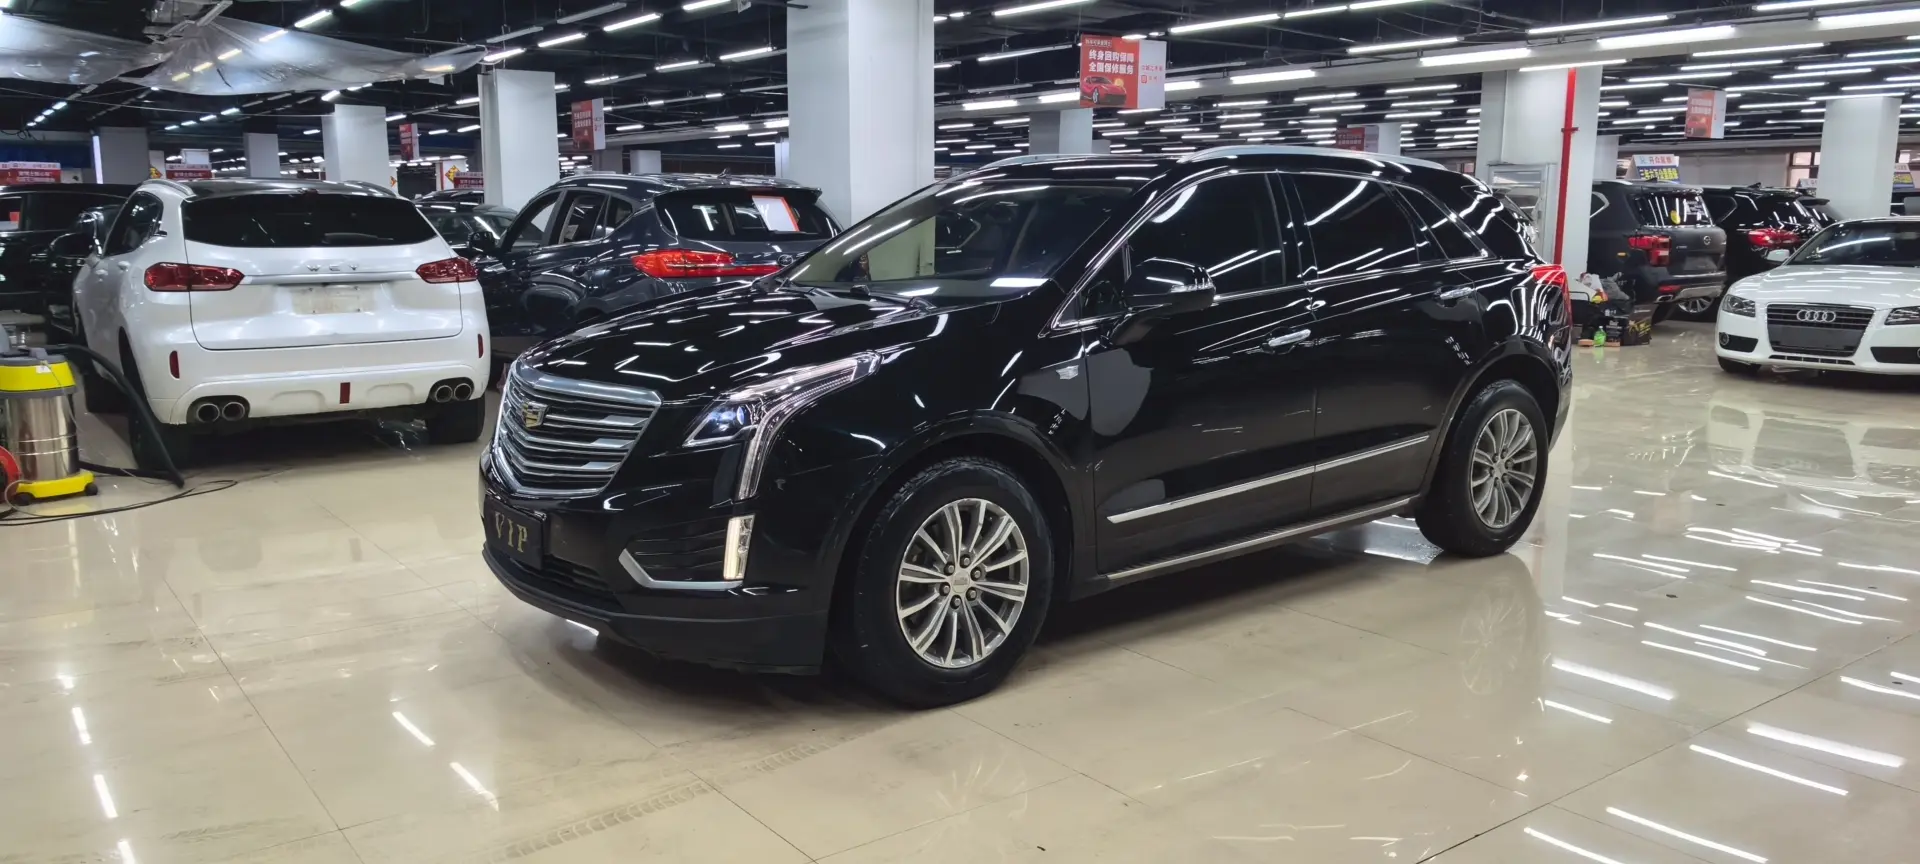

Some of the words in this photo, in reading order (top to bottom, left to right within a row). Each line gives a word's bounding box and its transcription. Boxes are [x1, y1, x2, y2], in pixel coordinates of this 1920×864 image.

[1089, 49, 1134, 62] 终身回购保障
[1089, 61, 1134, 75] 全国保修服务
[494, 511, 528, 553] VIP
